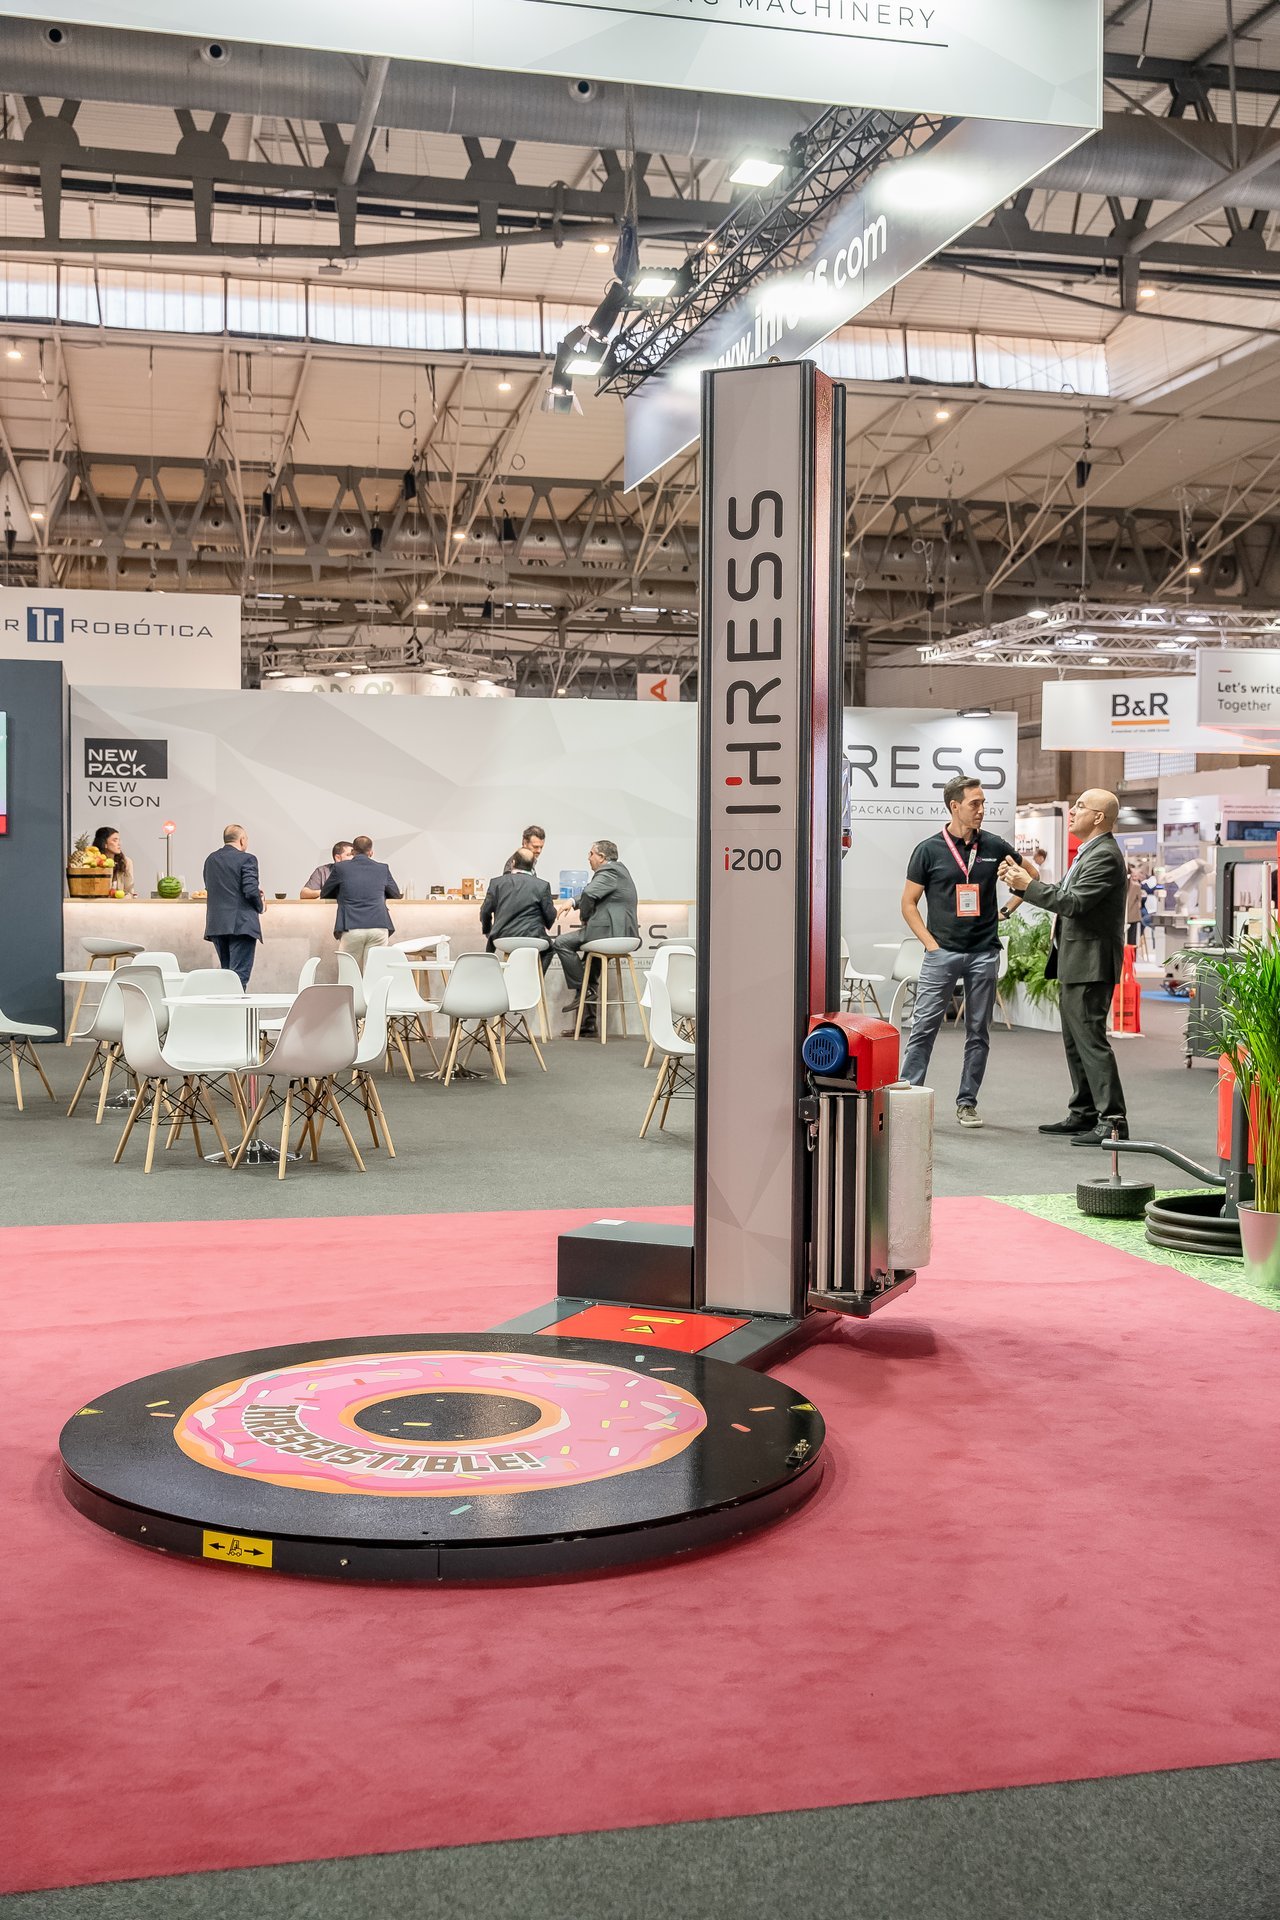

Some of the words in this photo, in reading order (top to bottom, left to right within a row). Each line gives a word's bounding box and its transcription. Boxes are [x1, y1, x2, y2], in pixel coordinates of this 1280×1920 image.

[71, 617, 213, 638] ROBÓTICA
[1217, 682, 1247, 693] Let's
[1250, 683, 1280, 694] write
[1111, 692, 1169, 717] B&R
[1217, 699, 1271, 713] Together
[88, 749, 138, 762] NEW
[88, 763, 147, 777] PACK
[89, 781, 137, 793] NEW
[88, 795, 161, 808] VISION
[851, 805, 924, 815] PACKAGING
[724, 847, 782, 871] i200
